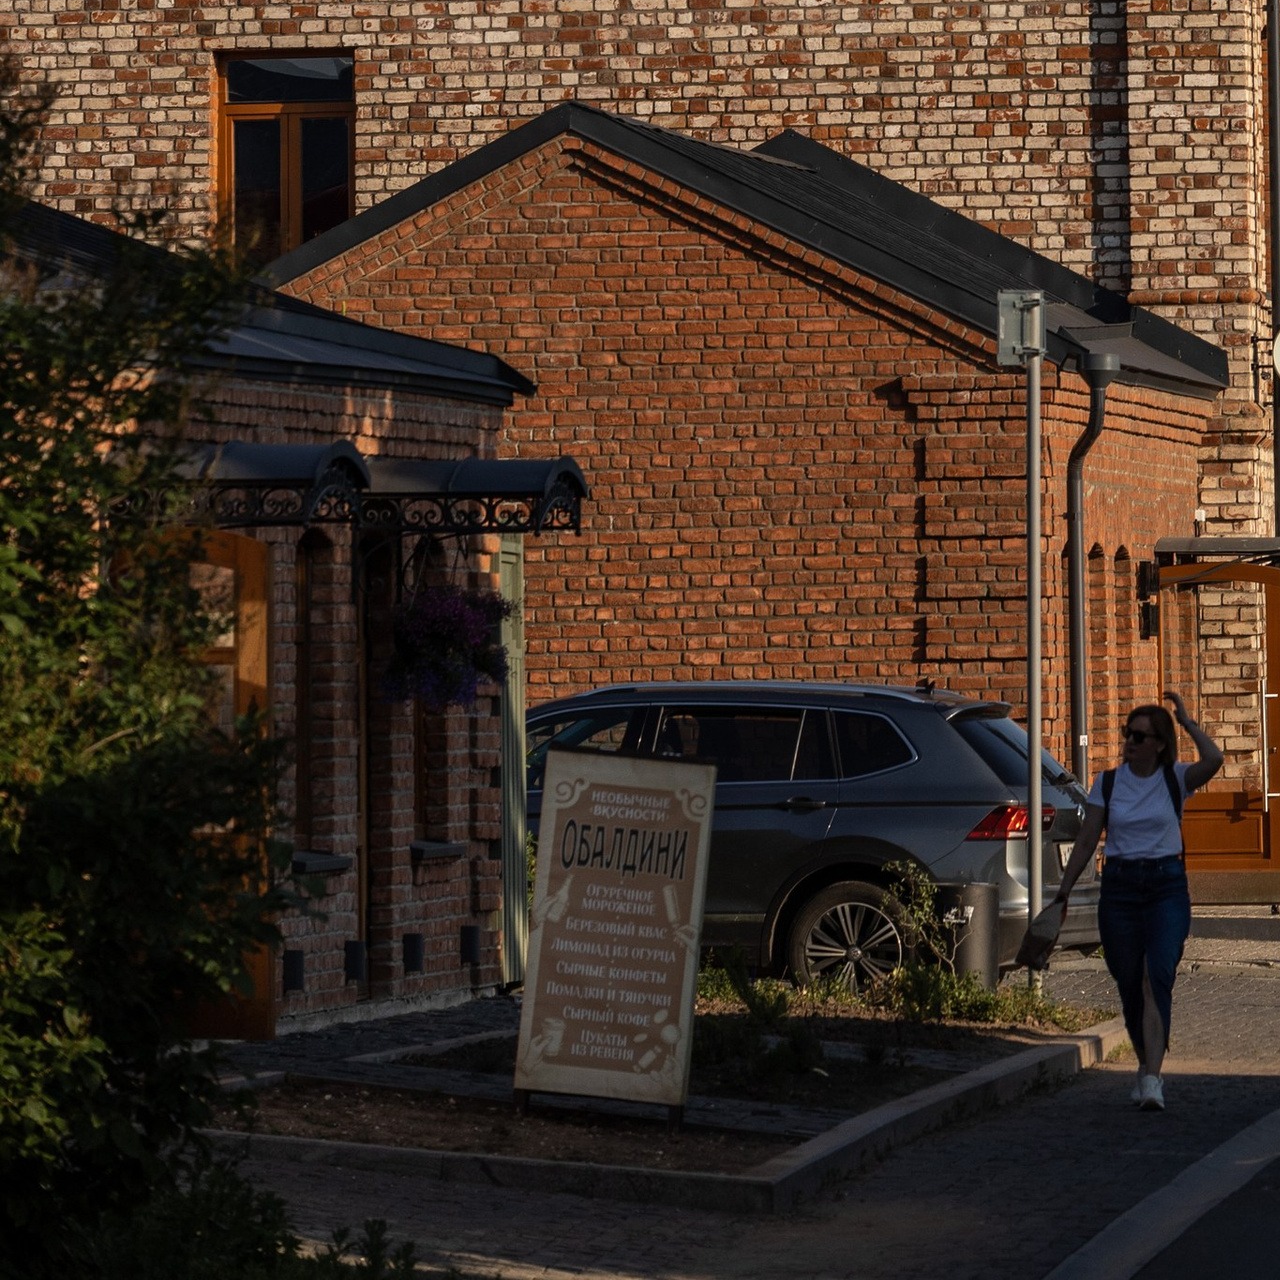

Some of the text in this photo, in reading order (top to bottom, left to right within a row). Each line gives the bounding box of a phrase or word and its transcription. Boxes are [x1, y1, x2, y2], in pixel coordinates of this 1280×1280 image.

[591, 790, 671, 810] НЕОБЫЧНЫЕ
[562, 819, 688, 880] ОБАЛДИНИ
[586, 884, 655, 903] ОГУРЕЧНОЕ
[581, 898, 656, 916] МОРОЖЕНОЕ
[565, 916, 668, 940] БЕРЕЗОВЫЙ КВАС
[550, 938, 677, 964] ЛИМОНАД ИЗ ОГУРЦА
[556, 960, 667, 985] СЫРНЫЕ КОНФЕТЫ
[546, 981, 672, 1007] ПОМАДКИ И ТЯНУЧКИ
[562, 1005, 651, 1028] СЫРНЫЙ КОФЕ
[580, 1029, 628, 1047] ЦУКАТЫ
[570, 1044, 635, 1062] ИЗ РЕВЕНЯ
